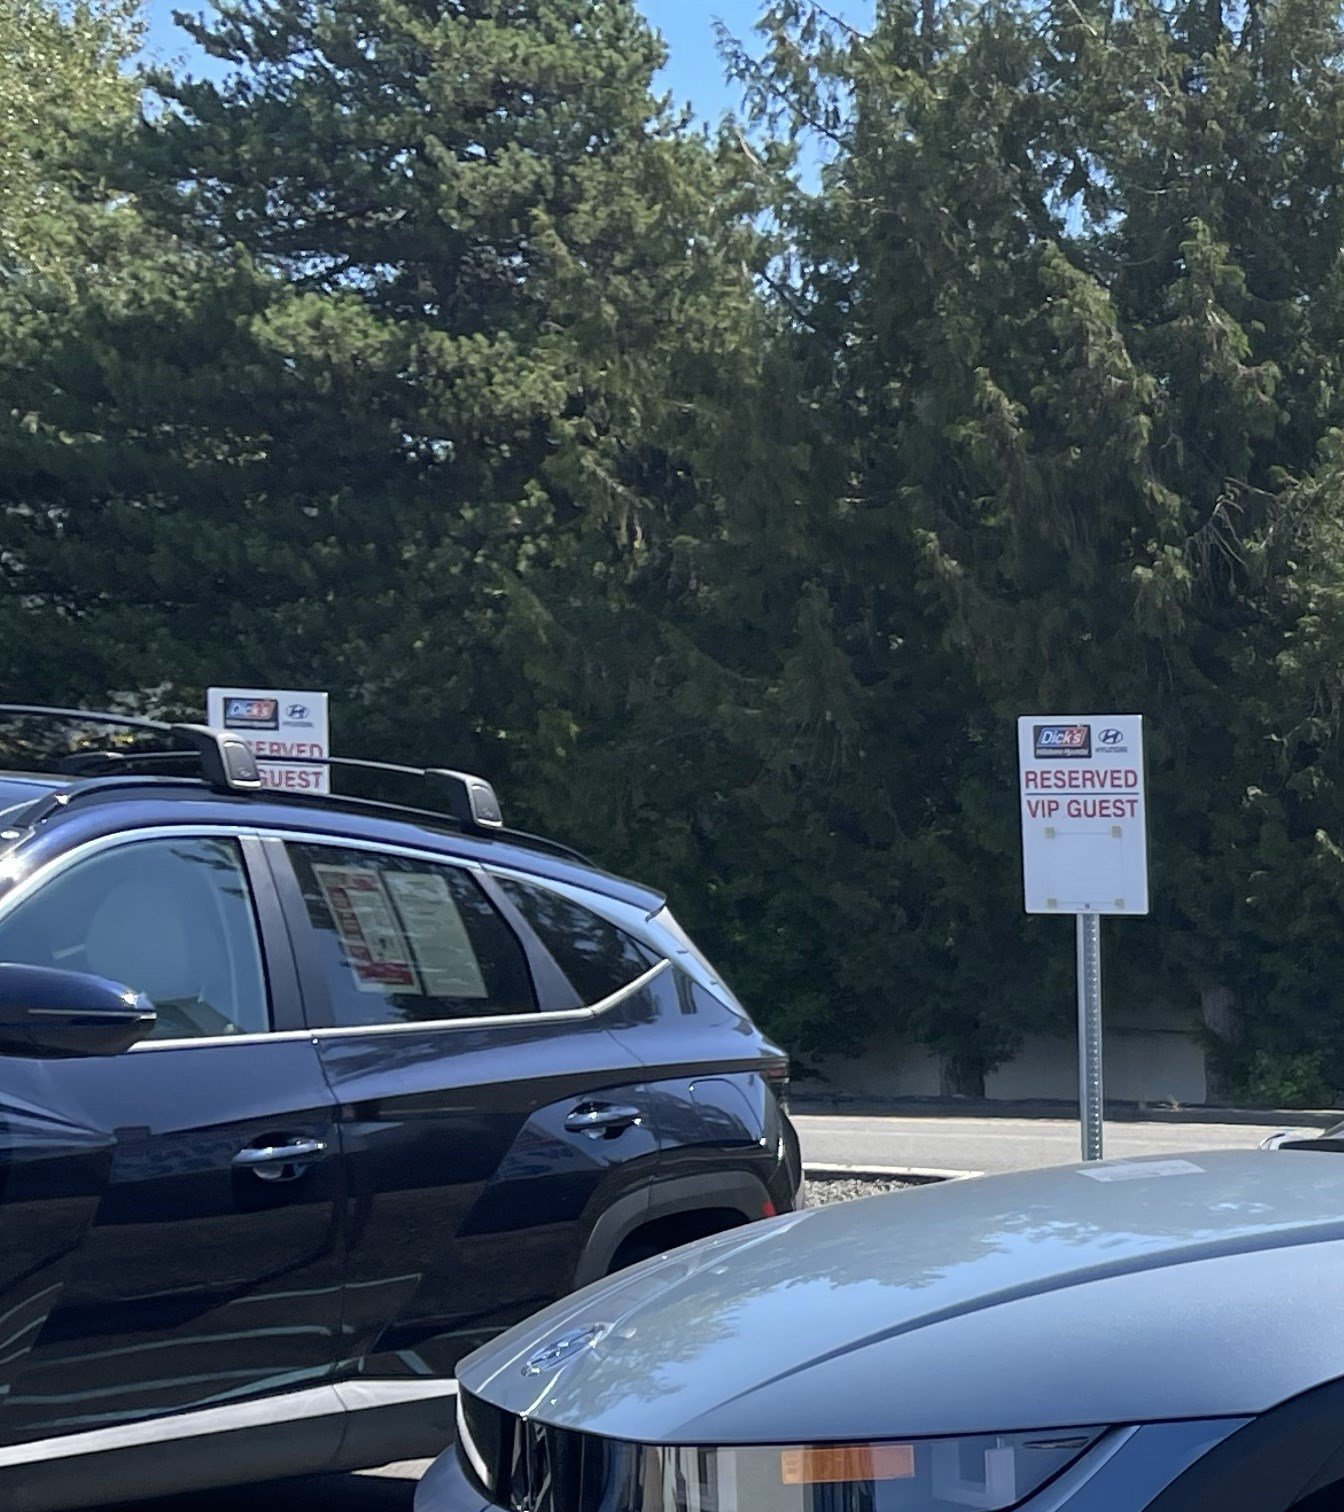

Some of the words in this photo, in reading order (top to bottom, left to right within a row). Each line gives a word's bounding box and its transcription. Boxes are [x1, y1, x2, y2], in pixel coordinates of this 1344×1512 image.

[1025, 769, 1138, 788] RESERVED
[1027, 799, 1060, 818] VIP
[1066, 799, 1138, 818] GUEST
